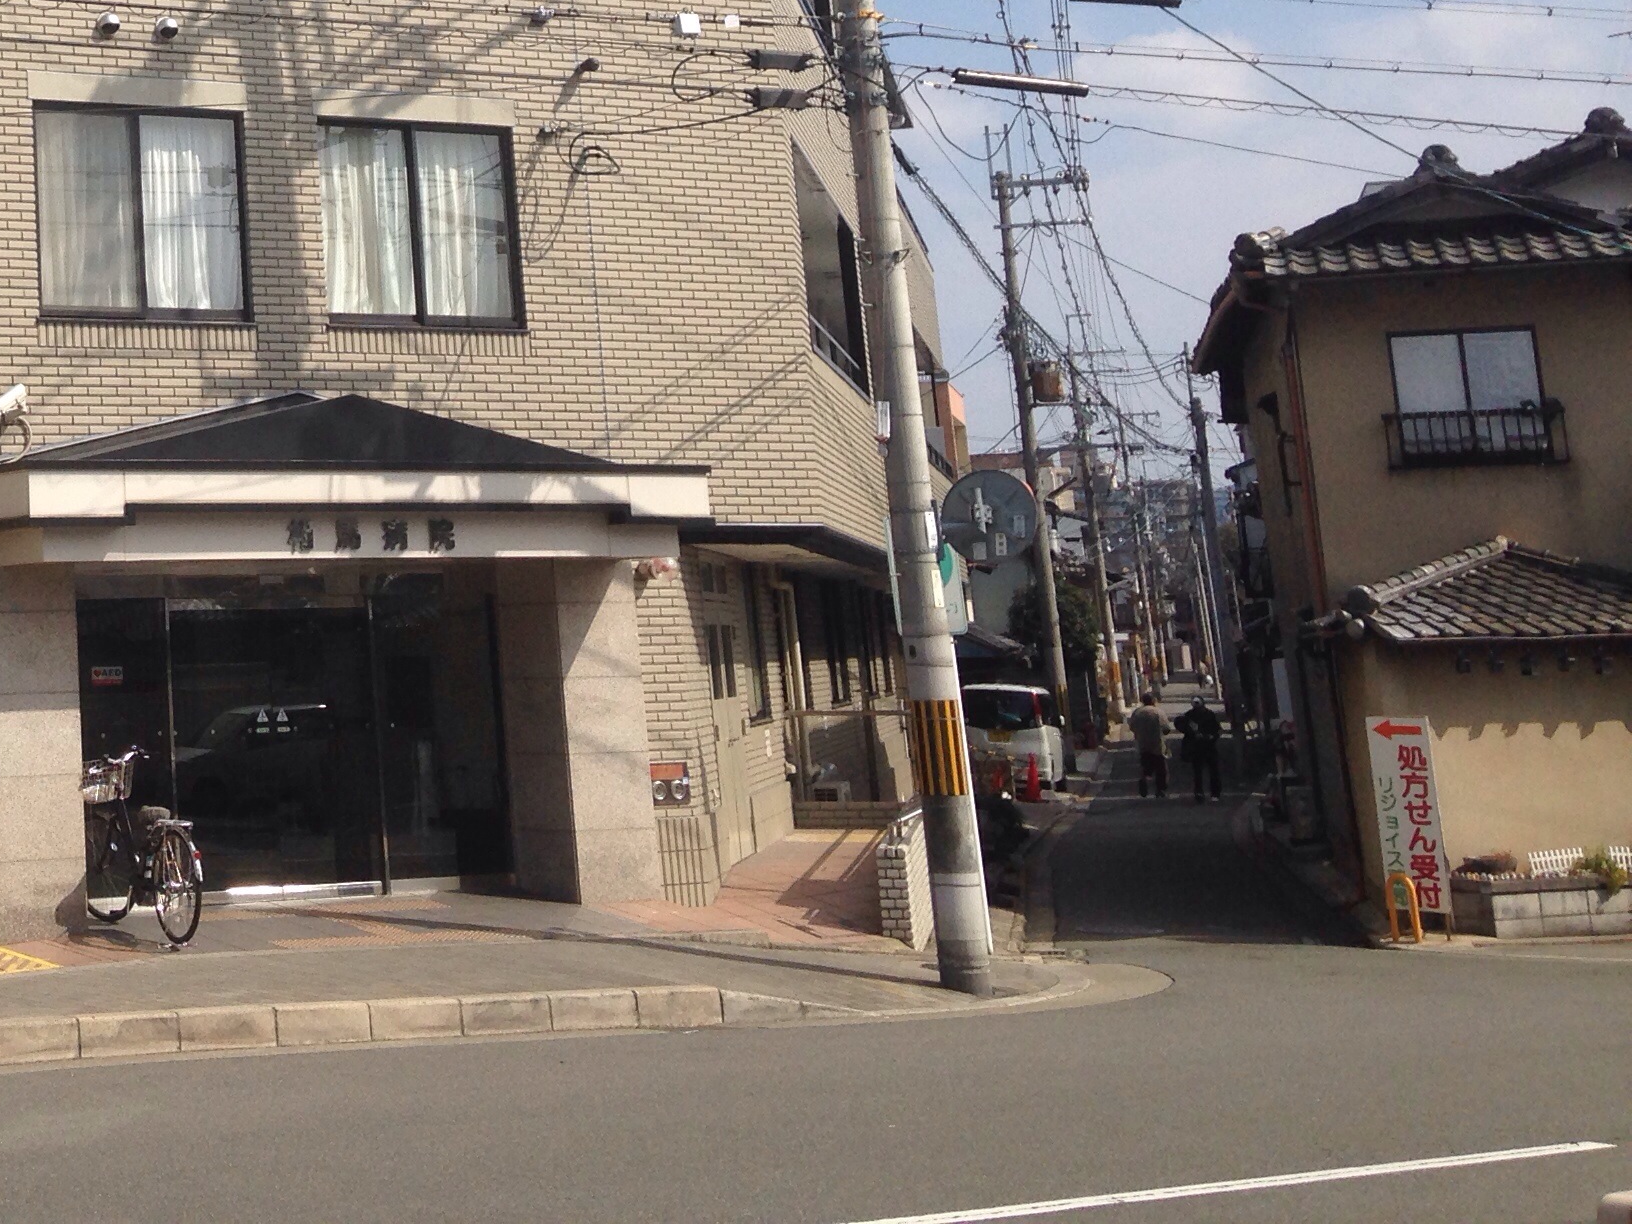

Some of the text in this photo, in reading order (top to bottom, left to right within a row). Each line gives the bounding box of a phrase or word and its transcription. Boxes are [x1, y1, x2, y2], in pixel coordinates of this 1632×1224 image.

[1397, 744, 1442, 909] 処方せん受付
